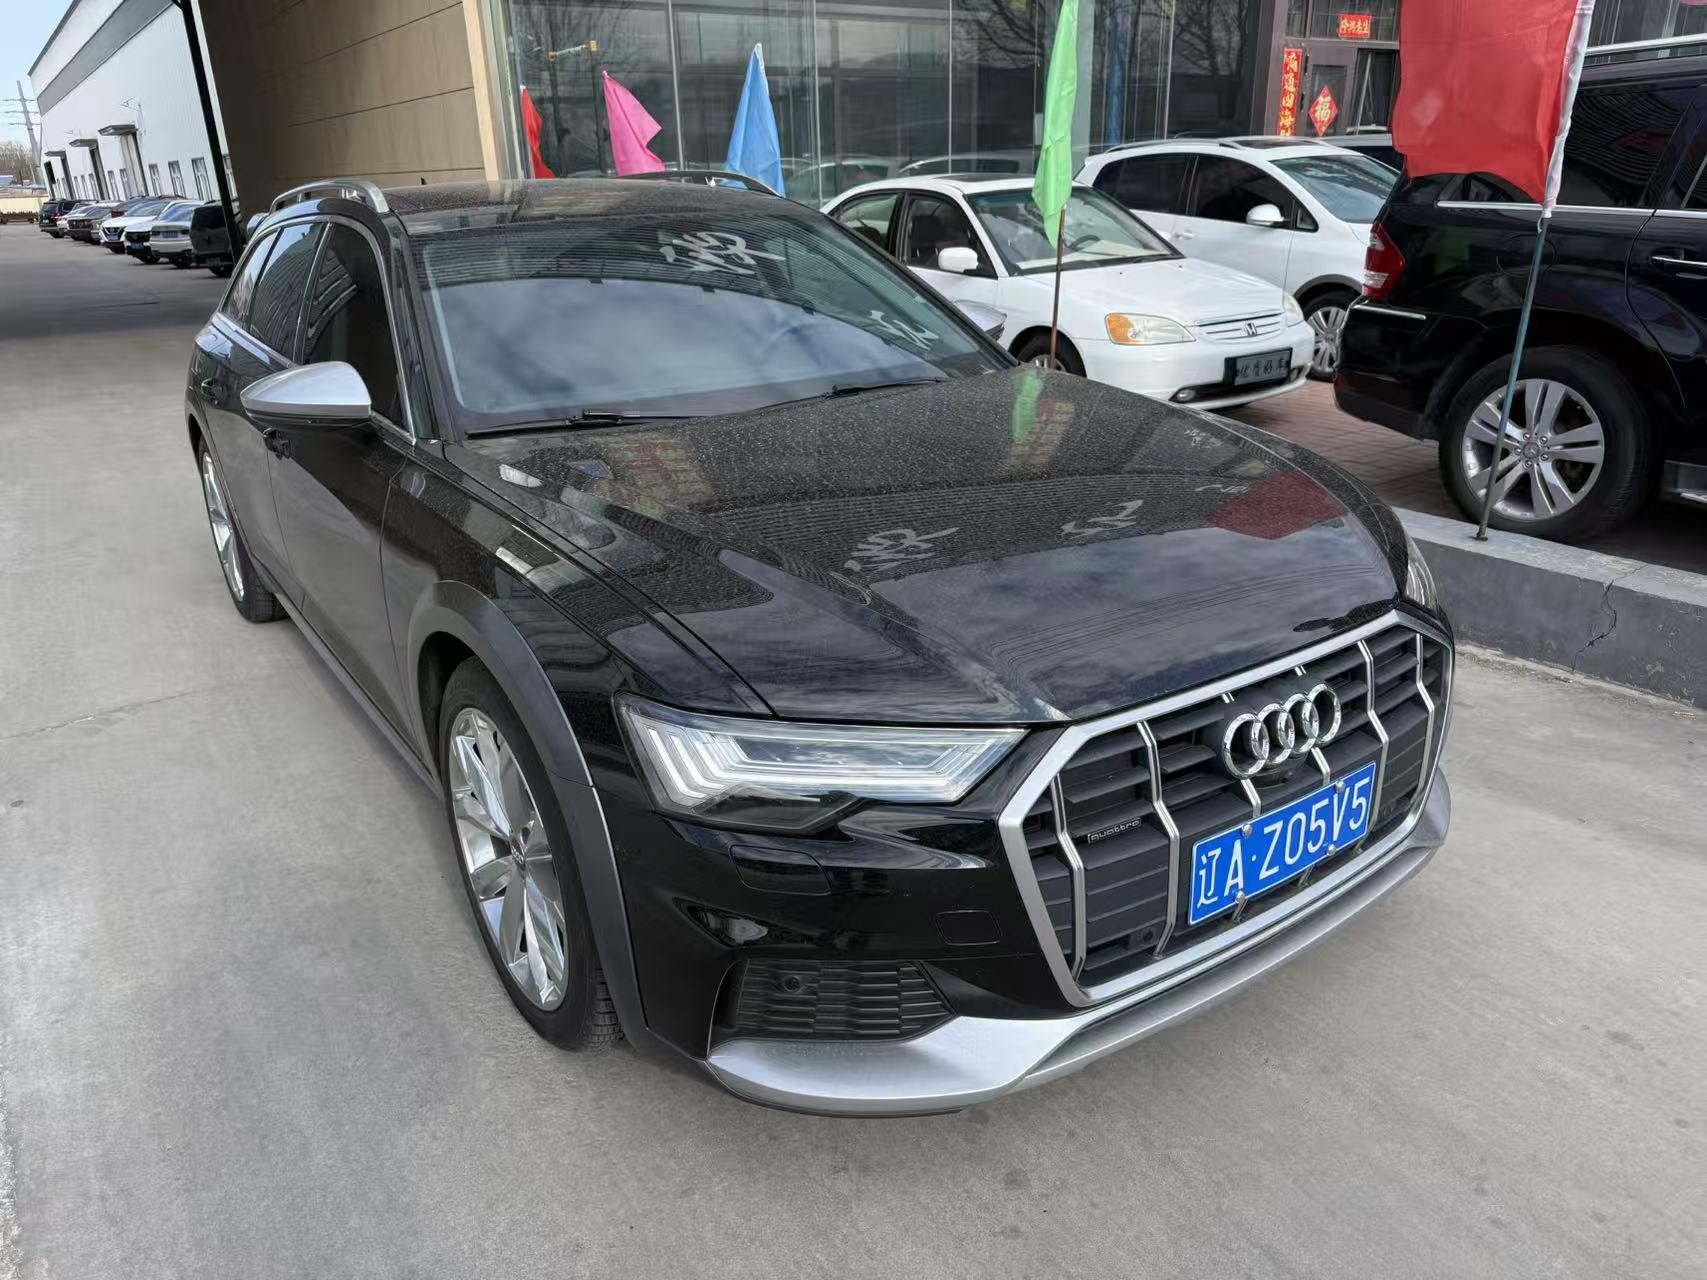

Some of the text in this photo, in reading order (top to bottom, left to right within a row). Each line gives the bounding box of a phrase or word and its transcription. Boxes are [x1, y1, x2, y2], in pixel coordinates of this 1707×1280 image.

[1315, 96, 1331, 120] 福
[1090, 820, 1140, 841] quattro
[1197, 776, 1370, 908] 辽A·Z05V5
